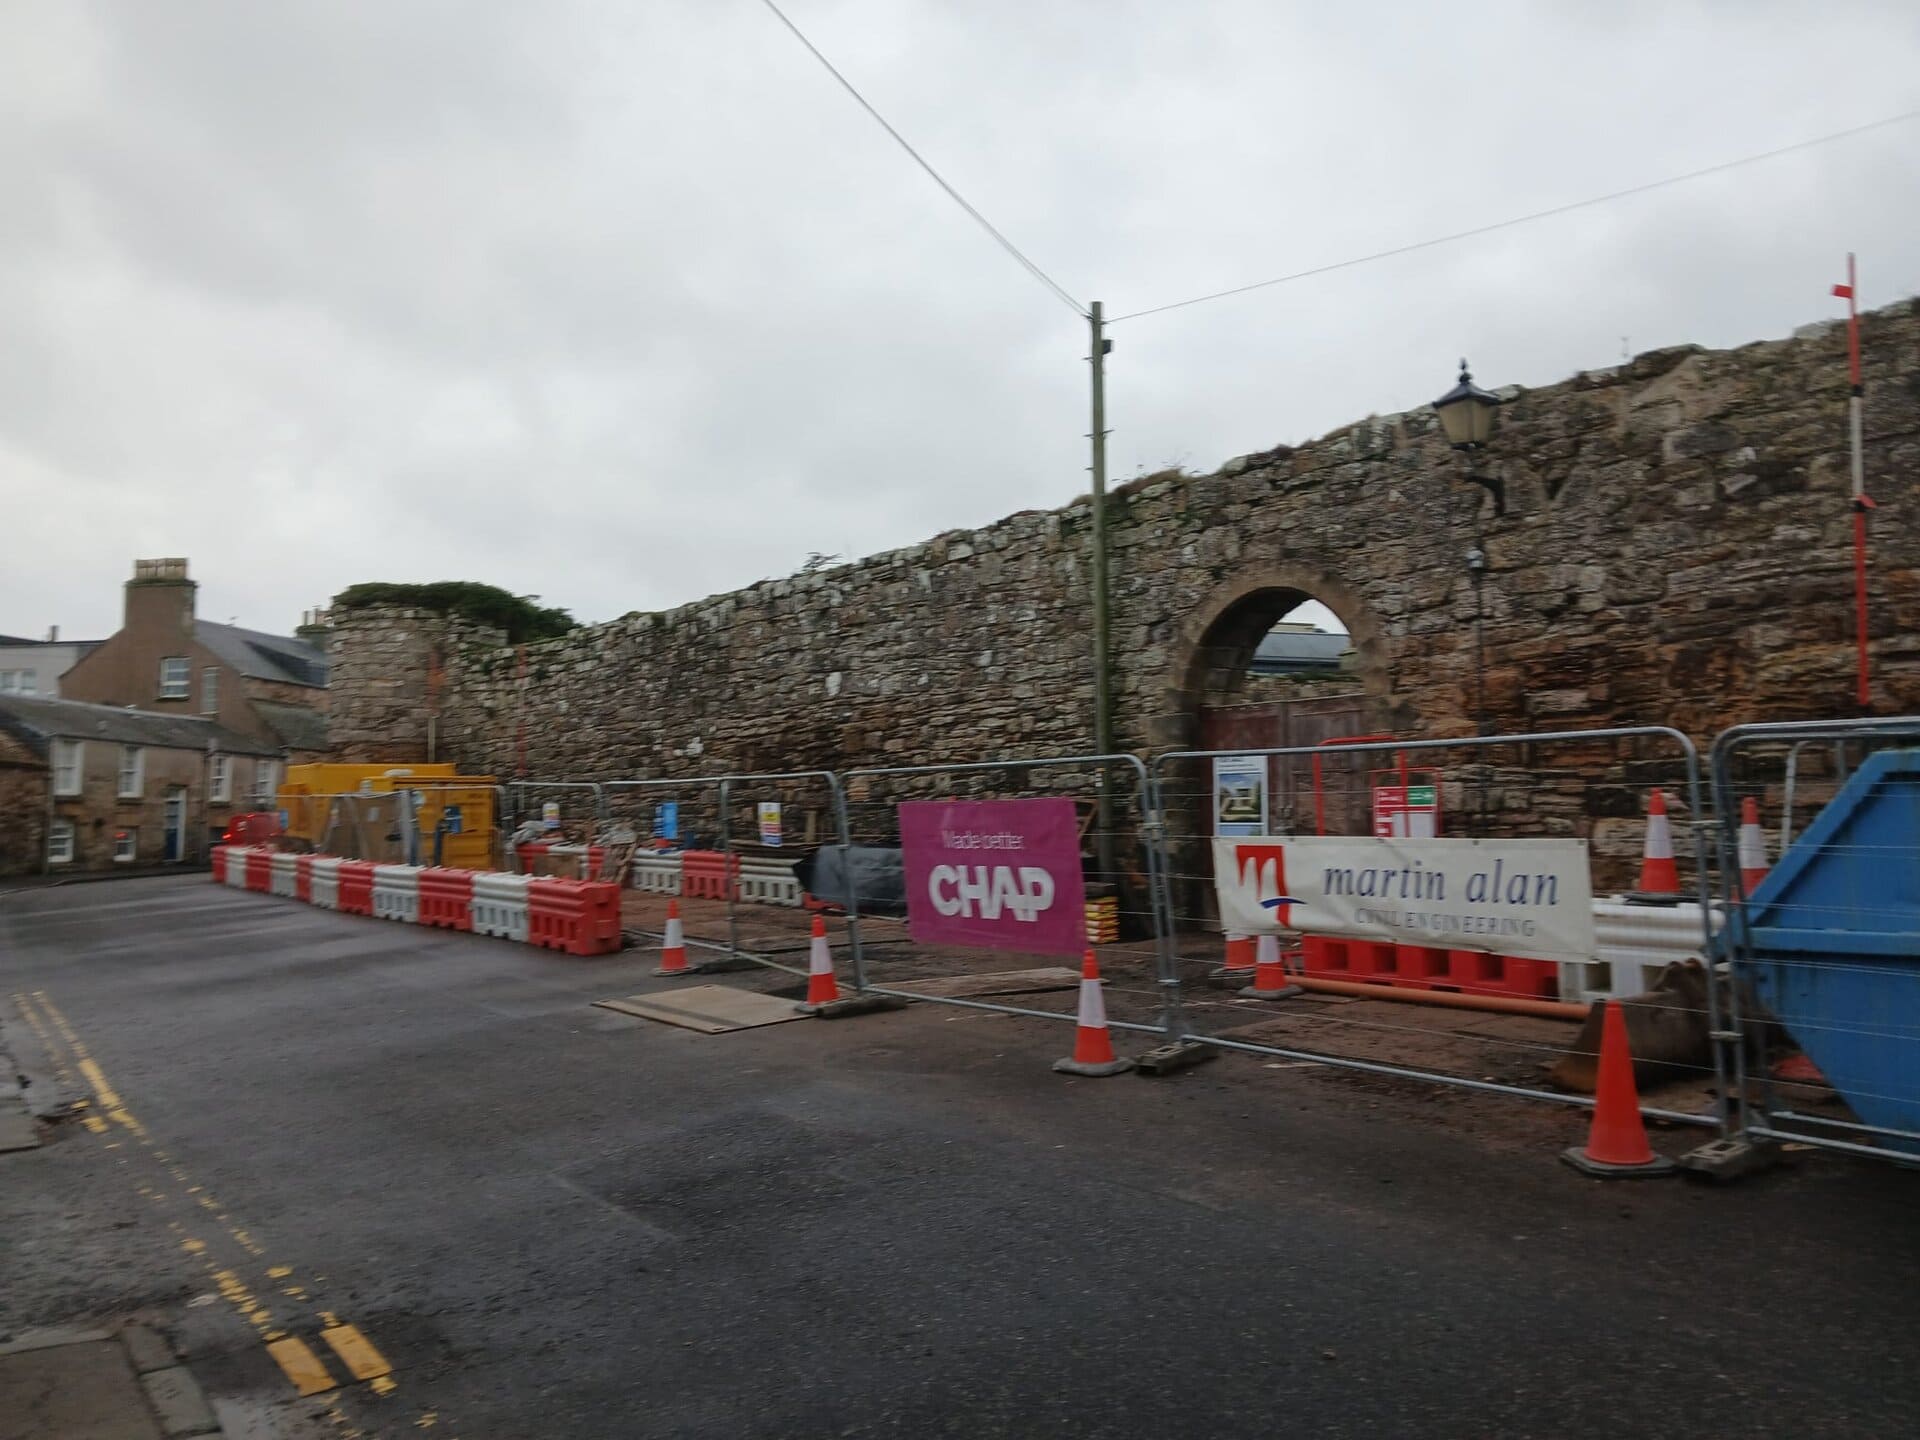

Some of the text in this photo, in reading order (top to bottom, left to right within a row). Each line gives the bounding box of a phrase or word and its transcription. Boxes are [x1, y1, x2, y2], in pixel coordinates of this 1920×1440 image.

[928, 864, 1055, 922] CHAP
[1323, 858, 1558, 905] martin alan
[1405, 911, 1536, 937] ENGINEERING
